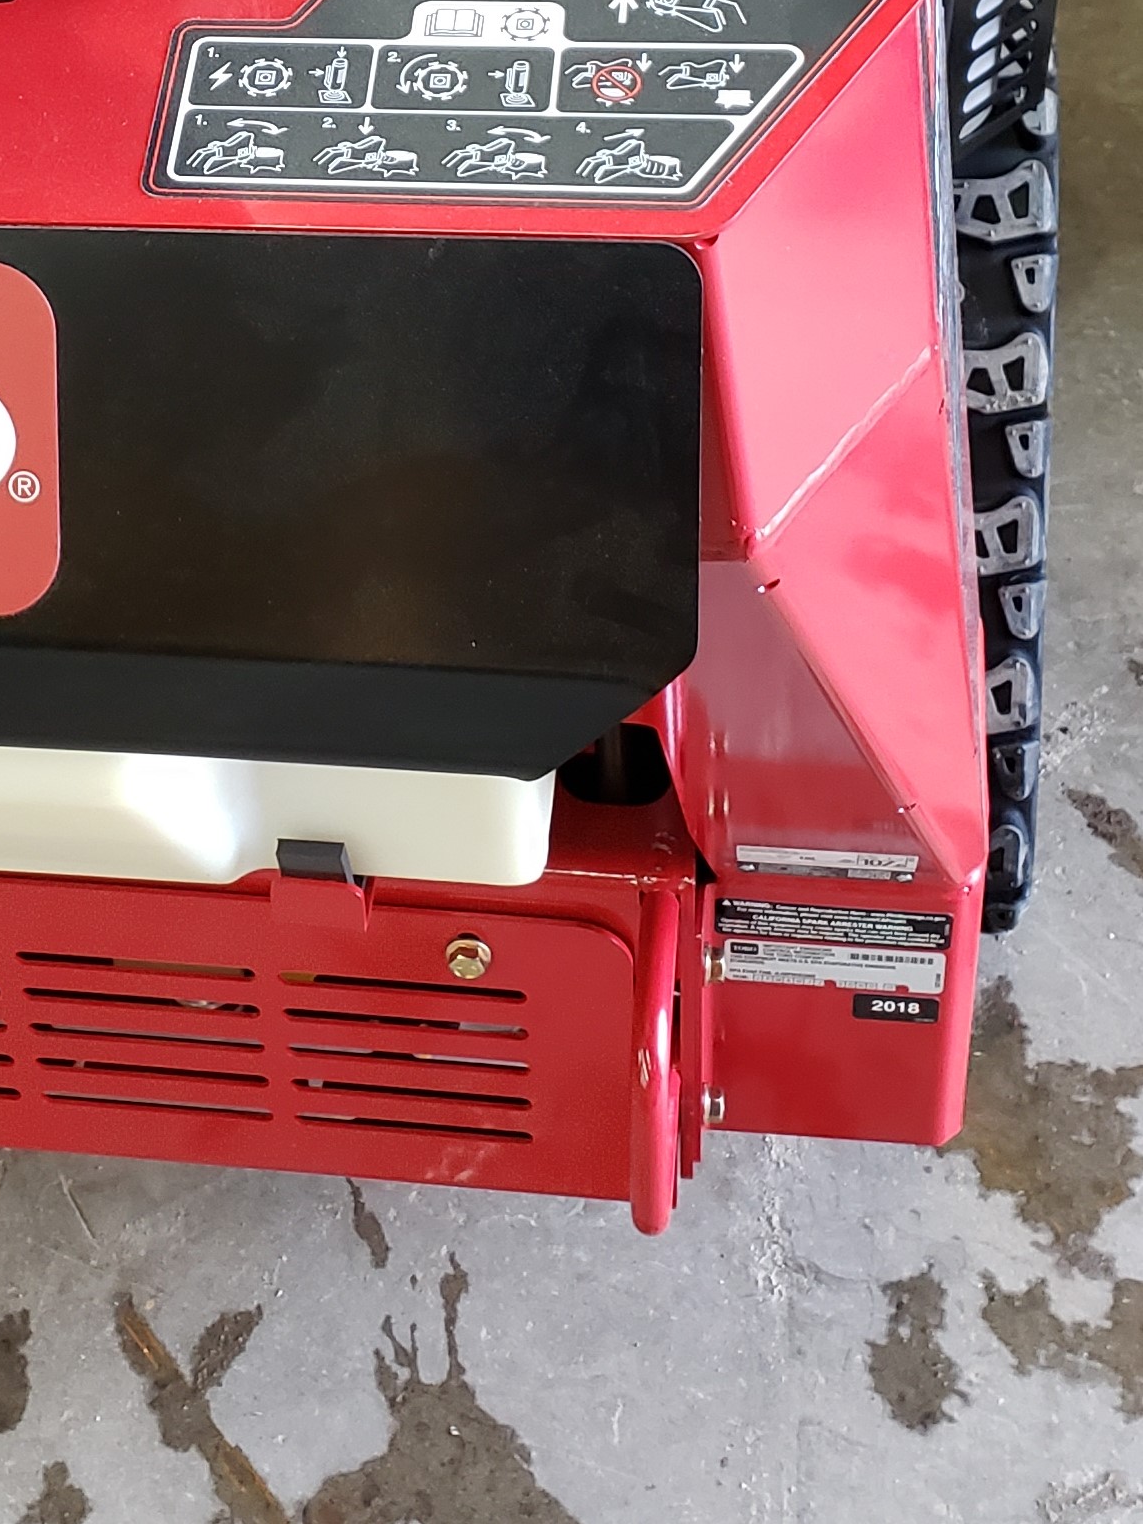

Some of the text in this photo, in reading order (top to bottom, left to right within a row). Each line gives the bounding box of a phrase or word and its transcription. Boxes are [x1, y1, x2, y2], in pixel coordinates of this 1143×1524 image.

[207, 46, 220, 58] 1.
[387, 51, 402, 63] 2.
[194, 113, 208, 126] 1.
[321, 116, 337, 129] 2.
[445, 119, 461, 131] 3.
[575, 121, 591, 134] 4.
[871, 999, 921, 1015] 2018
